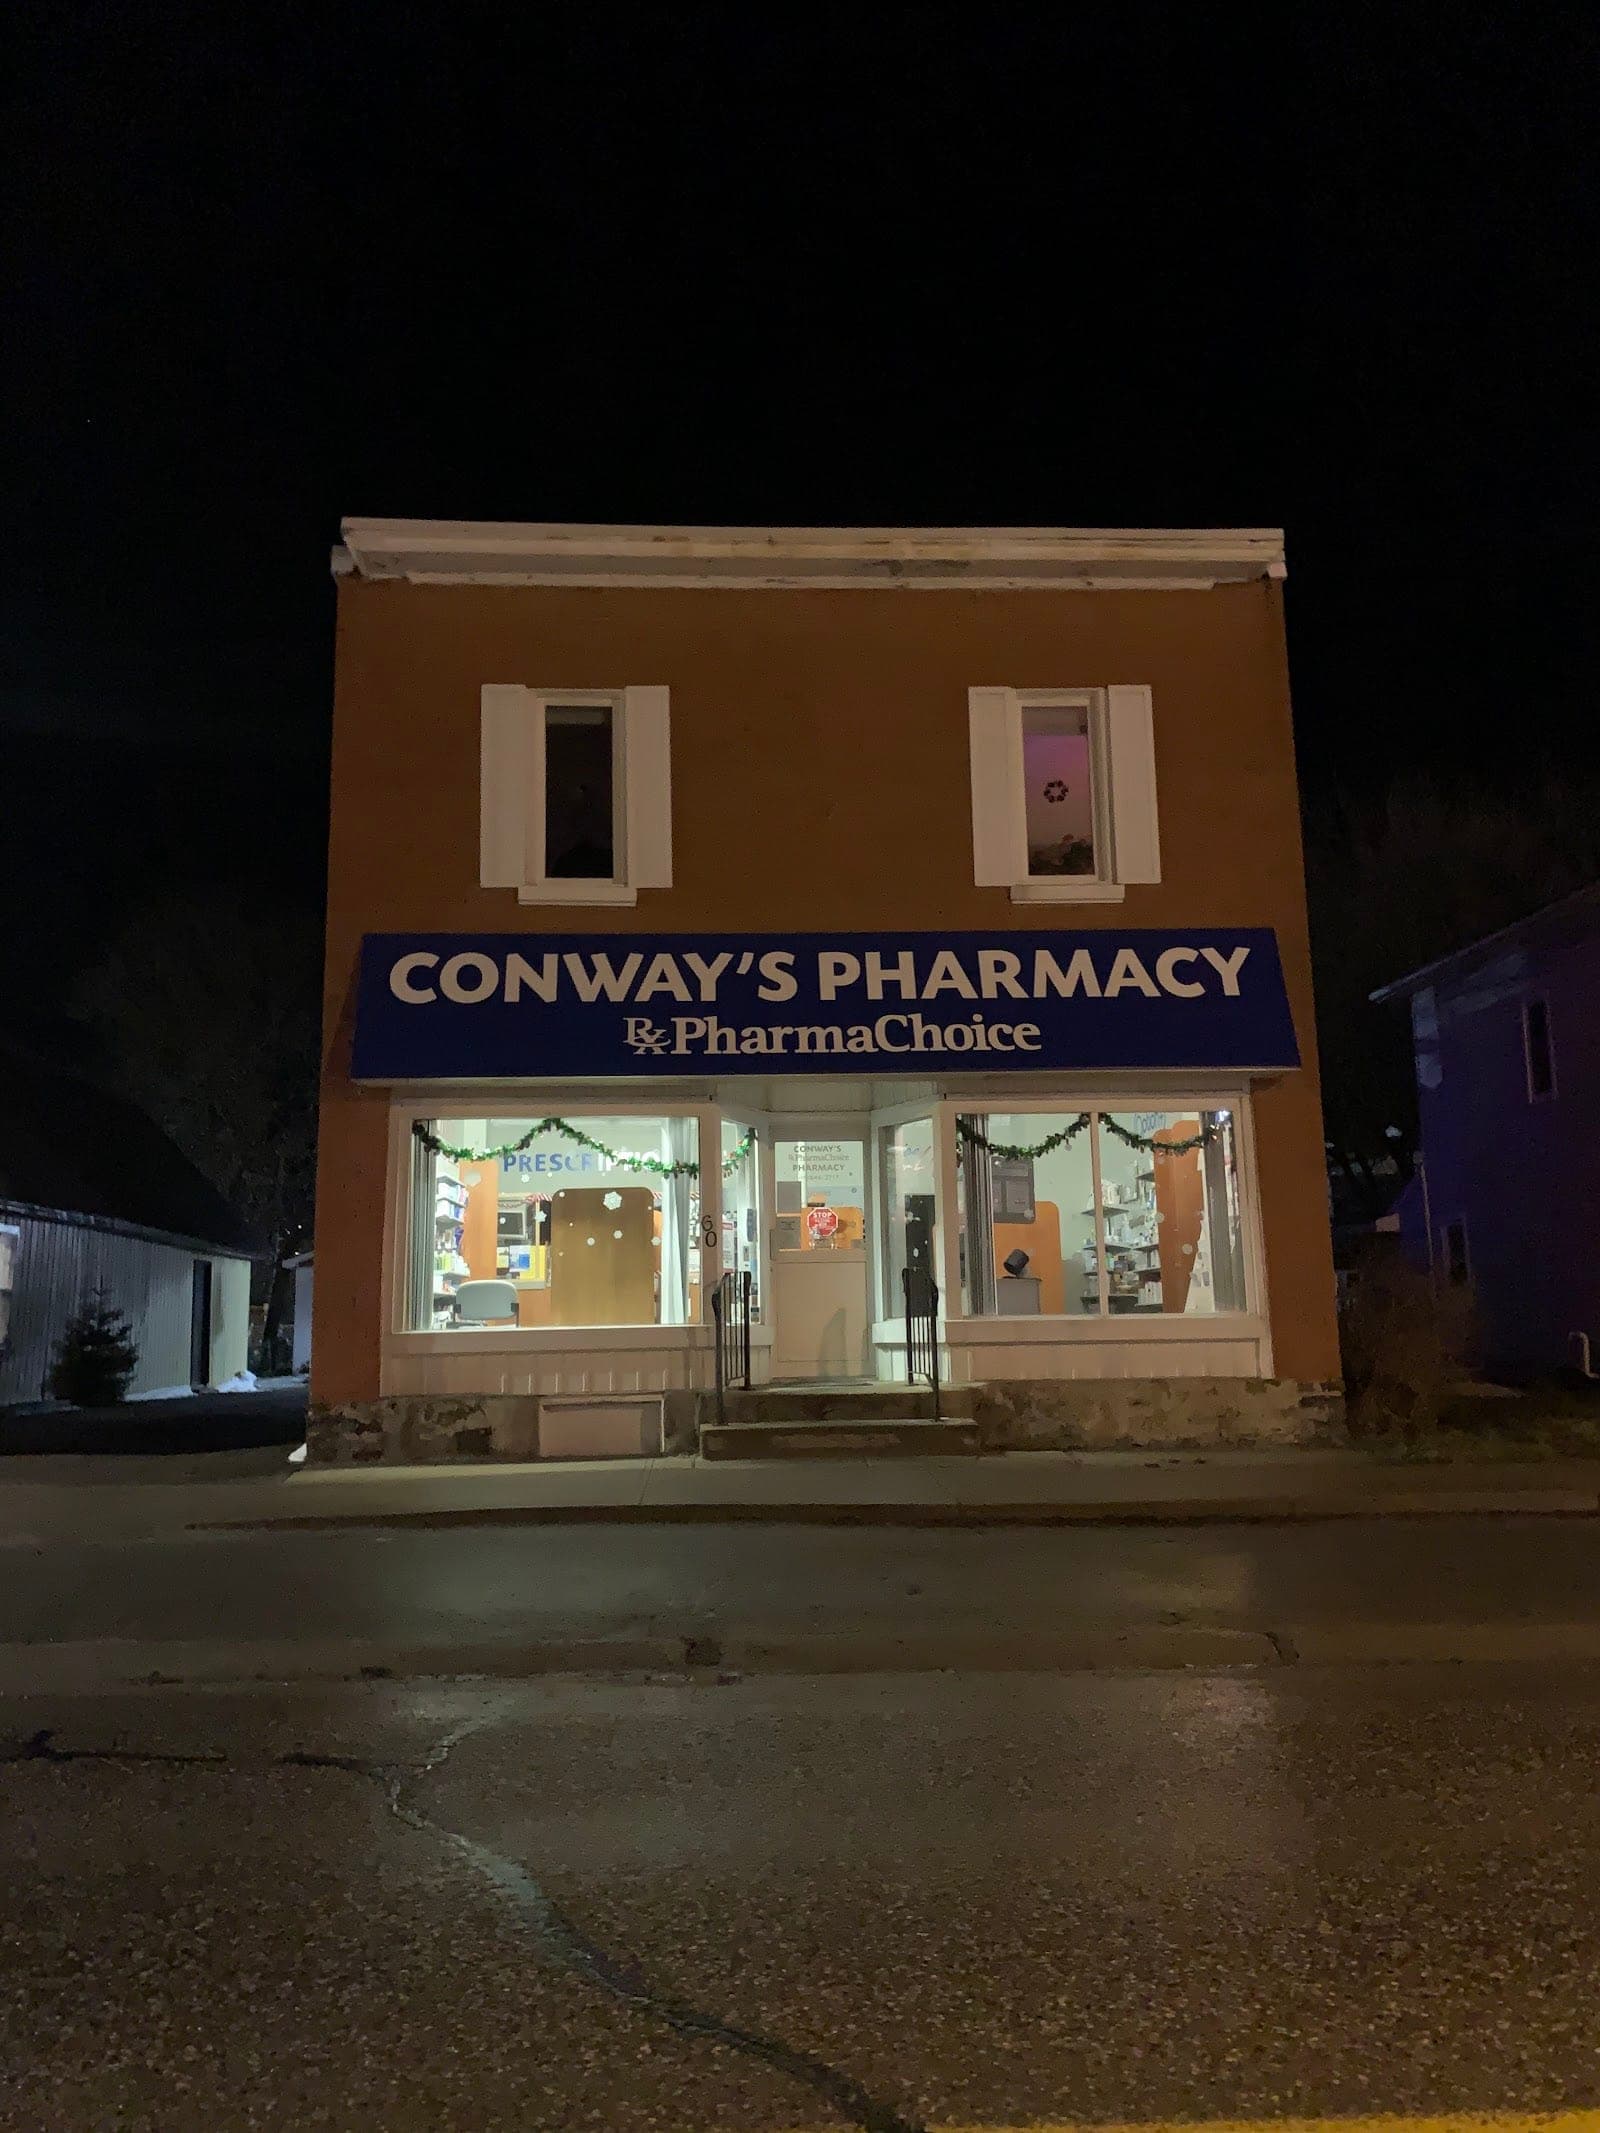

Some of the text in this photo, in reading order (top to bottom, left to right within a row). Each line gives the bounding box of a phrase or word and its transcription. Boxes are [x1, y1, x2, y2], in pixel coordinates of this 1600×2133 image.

[389, 945, 1252, 1004] CONWAY'S PHARMACY
[670, 1013, 1042, 1055] PharmaChoice
